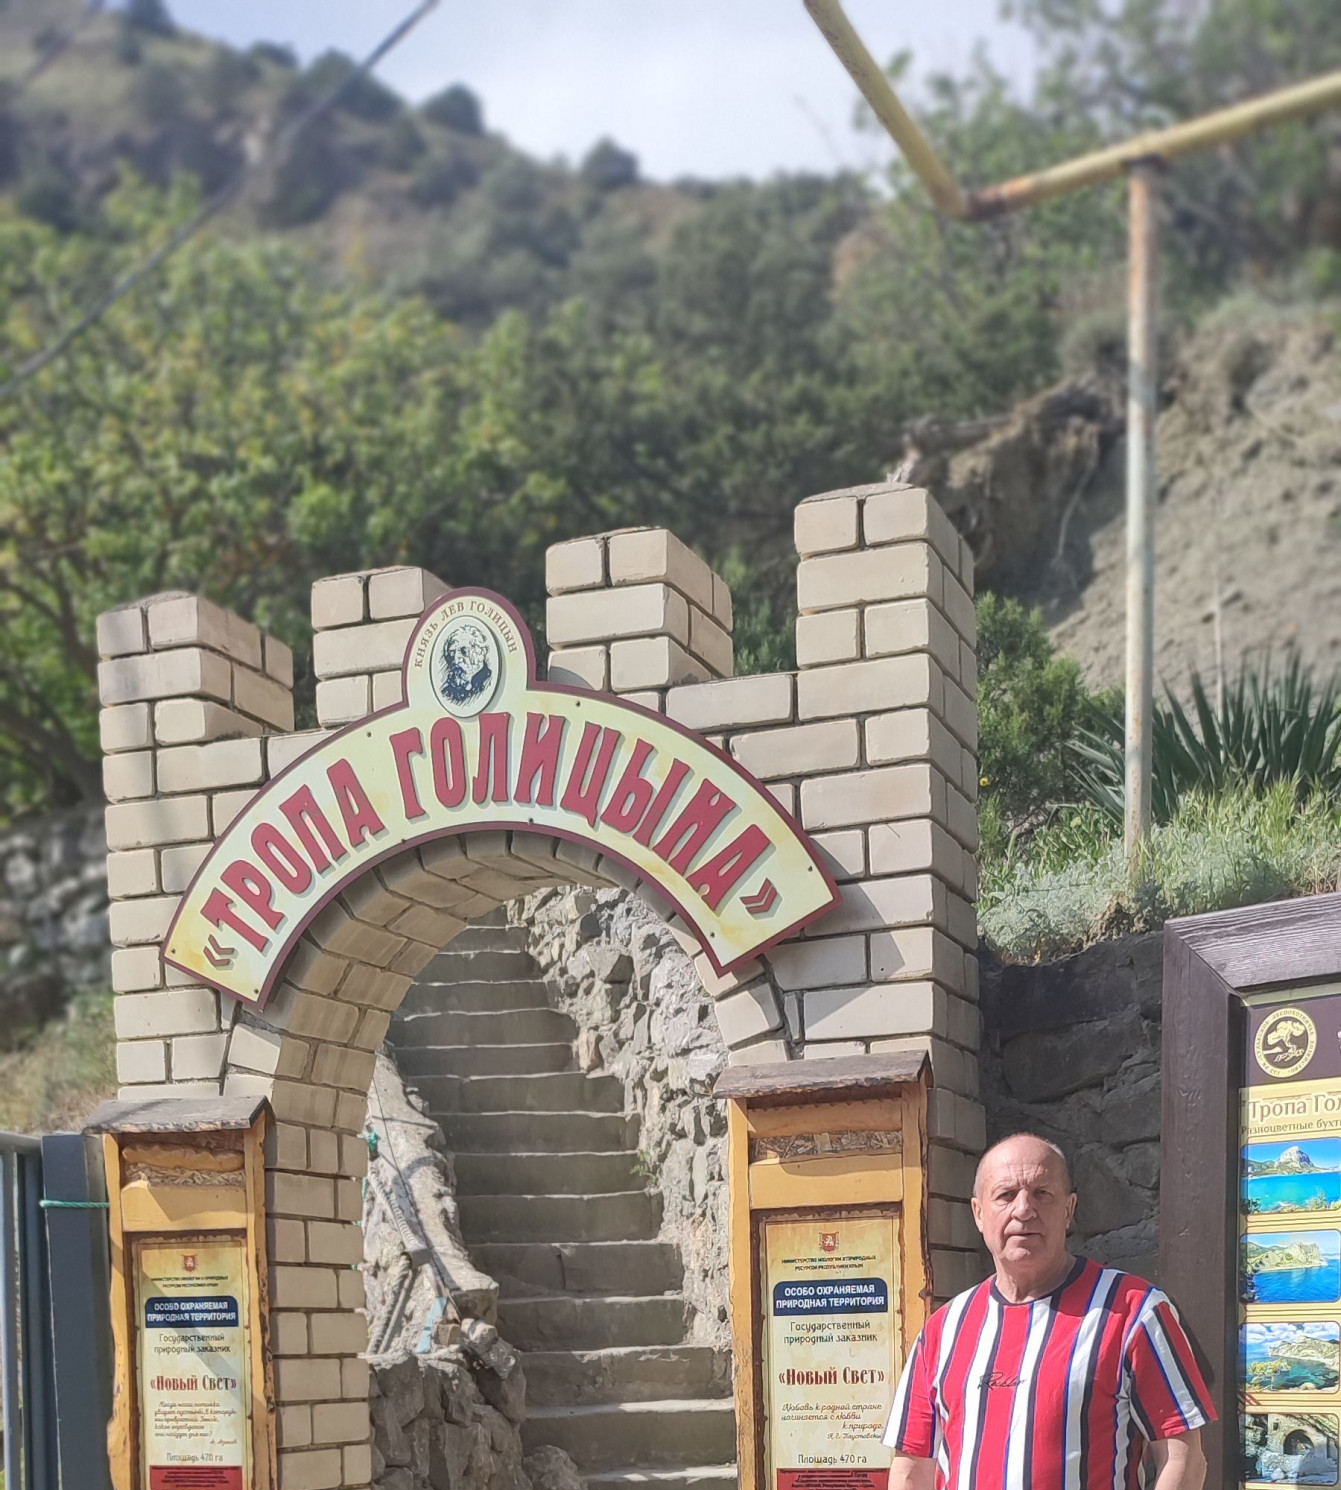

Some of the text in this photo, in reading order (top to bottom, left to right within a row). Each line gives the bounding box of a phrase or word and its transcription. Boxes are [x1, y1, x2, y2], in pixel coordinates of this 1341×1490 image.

[414, 601, 517, 668] КНЯЗЬ ЛЕВ ГОЛИЦЫН
[200, 711, 779, 967] «ТРОПА ГОЛИЦЫНА»
[1316, 1118, 1341, 1131] бухт
[784, 1284, 875, 1296] ОСОБО ОХРАНЯЕМАЯ
[154, 1302, 228, 1311] ОСОБО ОХРАНЯЕМАЯ
[776, 1296, 885, 1309] ПРИРОДНАЯ ТЕРРИТОРИЯ
[147, 1312, 236, 1322] ПРИРОДНАЯ ТЕРРИТОРИЯ
[790, 1320, 870, 1333] Государственный
[159, 1333, 224, 1344] Государственный
[784, 1333, 878, 1346] природный заказник
[154, 1345, 231, 1355] природный заказник
[778, 1366, 885, 1386] «Новый Свет»
[150, 1374, 237, 1391] «Новый Свет»
[821, 1403, 850, 1413] родной
[201, 1453, 213, 1462] 470
[215, 1454, 223, 1462] га
[798, 1453, 867, 1465] Площадь 470 га
